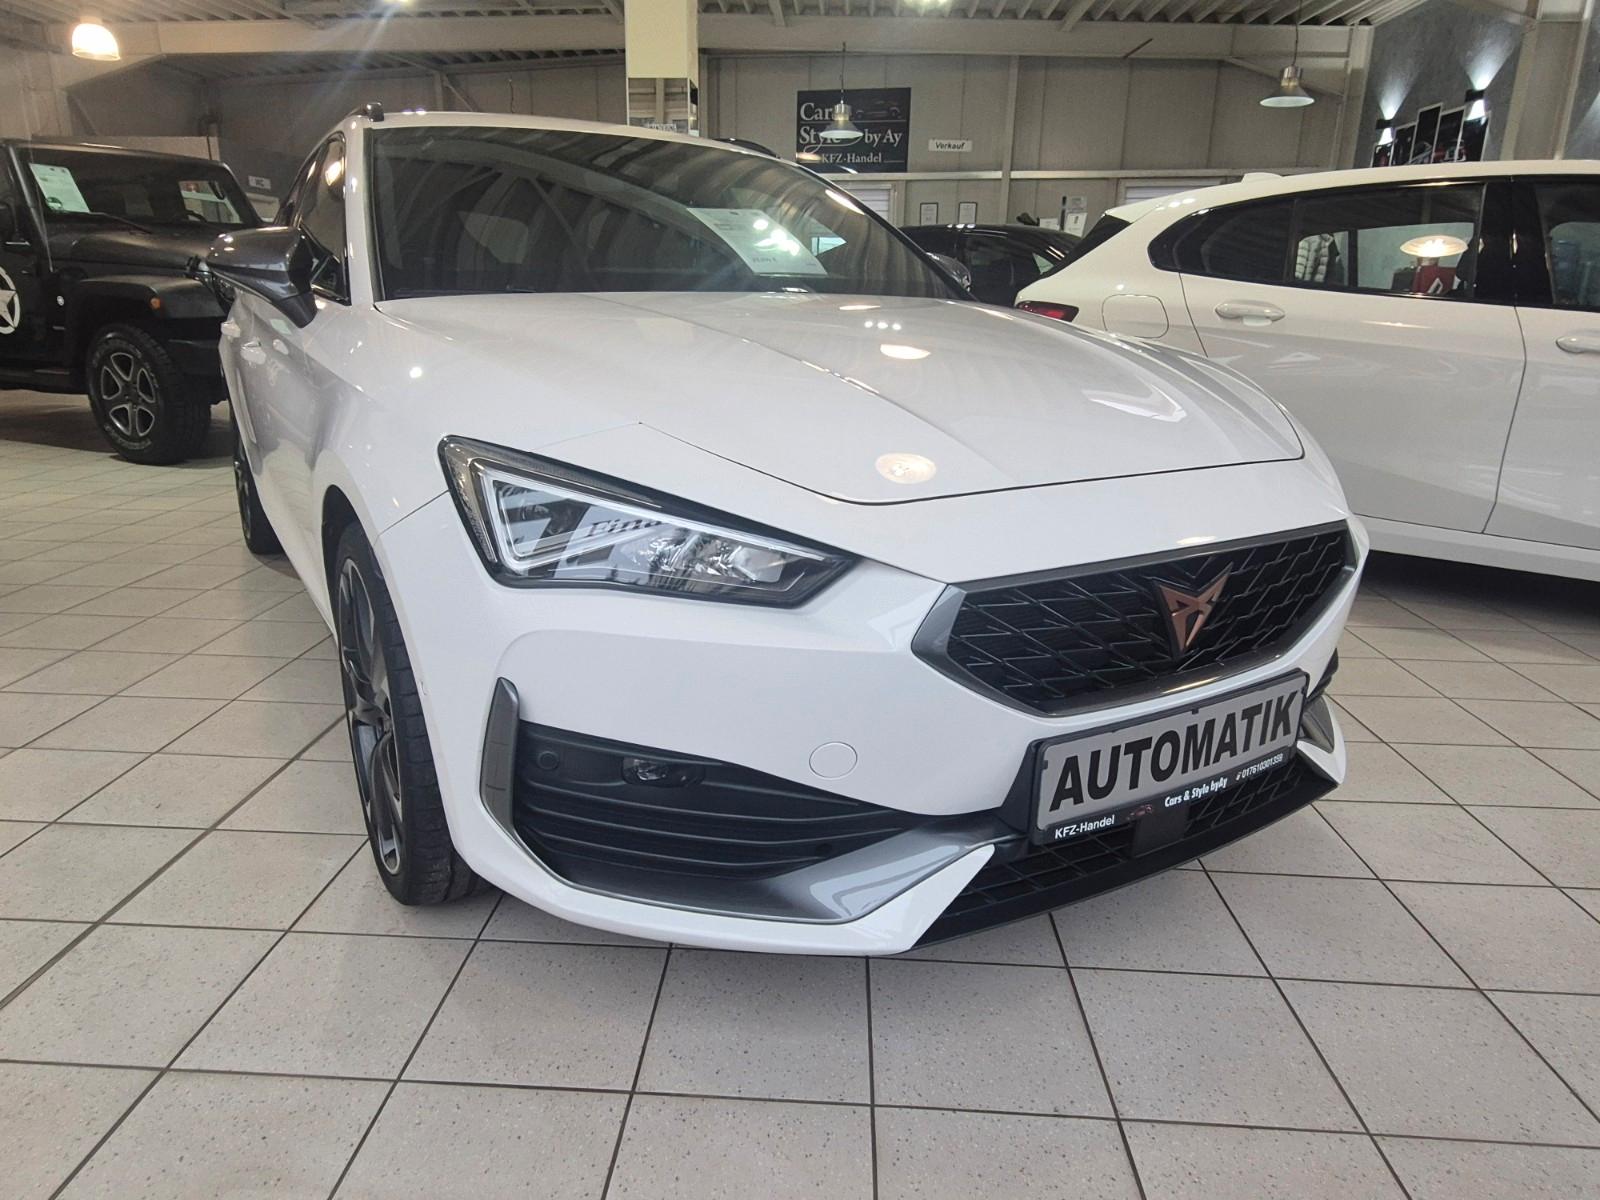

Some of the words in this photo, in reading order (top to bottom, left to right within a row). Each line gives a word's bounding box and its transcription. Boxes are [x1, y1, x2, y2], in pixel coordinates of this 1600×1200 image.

[800, 102, 834, 121] Car
[864, 129, 881, 147] by
[883, 129, 902, 147] Ay
[935, 141, 966, 150] Verkauf
[1049, 690, 1298, 812] AUTOMATIK
[1164, 795, 1182, 807] Cars
[1183, 790, 1190, 801] &
[1191, 783, 1209, 798] Style
[1054, 814, 1115, 838] KFZ-Handel
